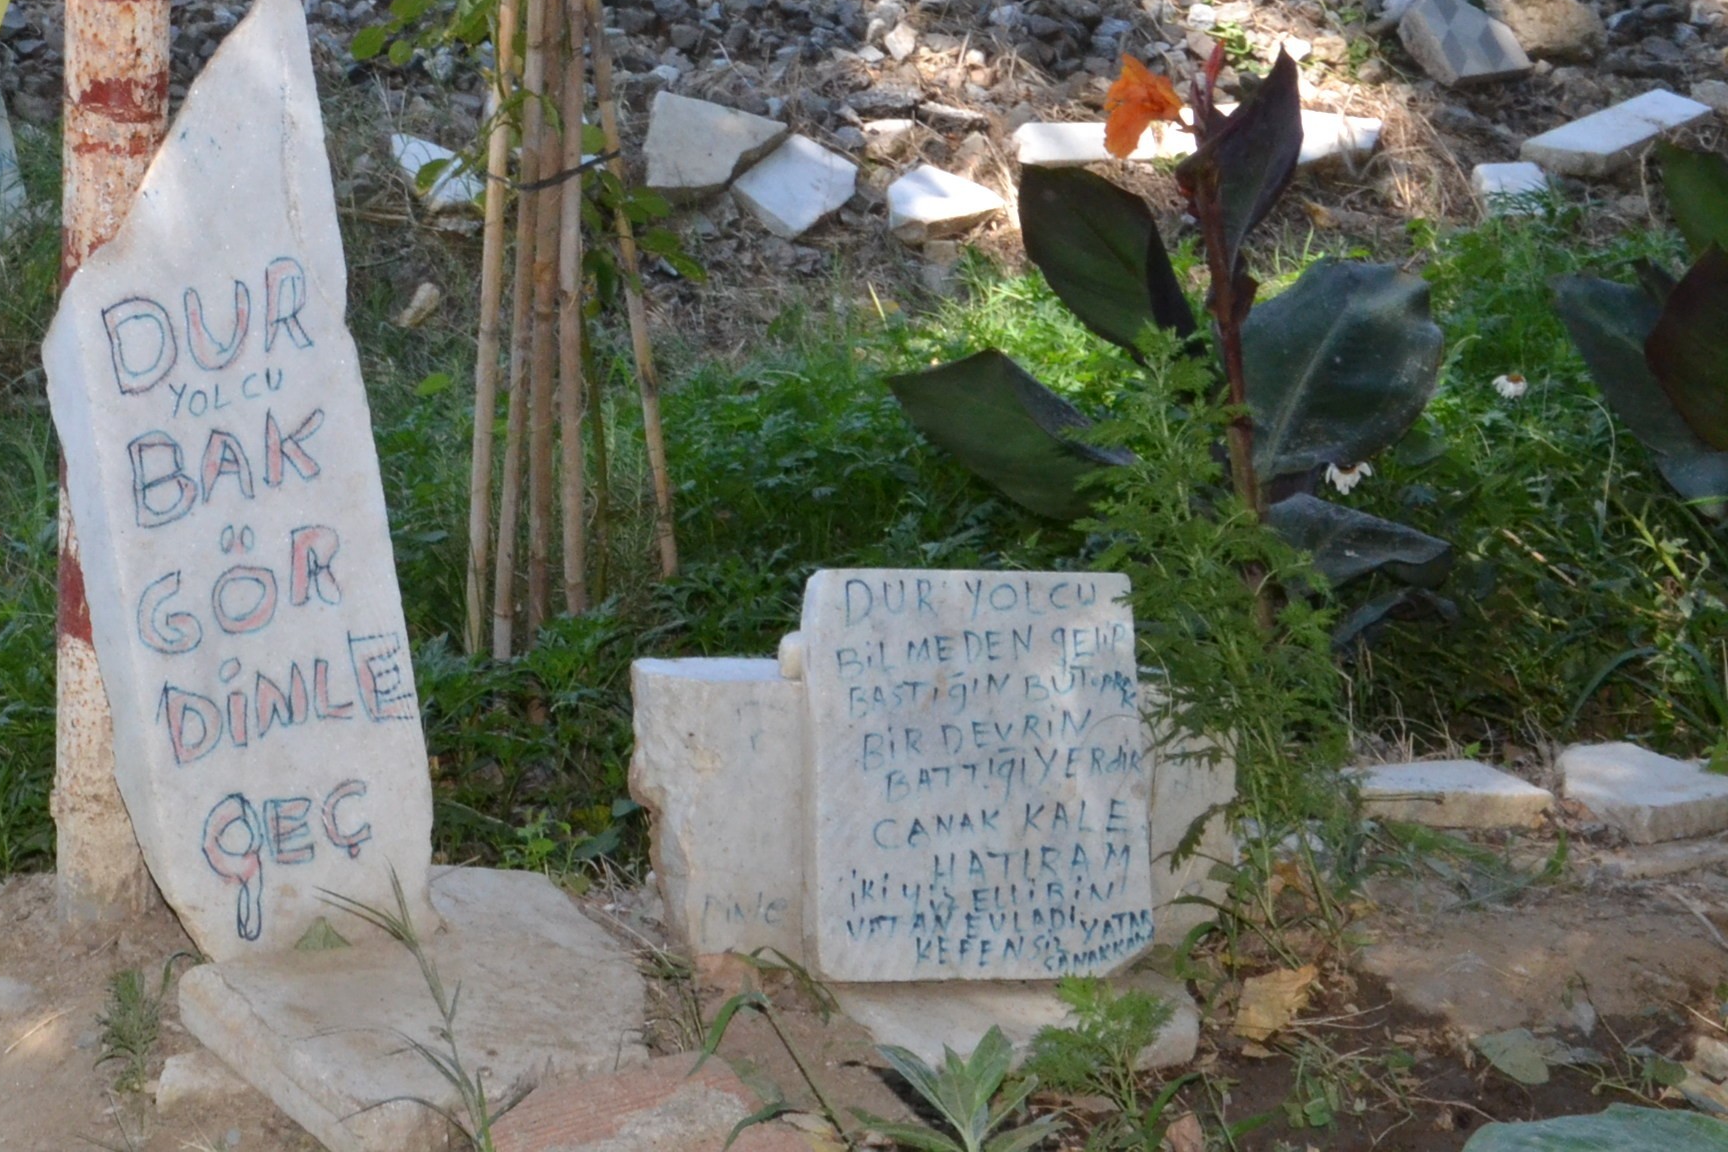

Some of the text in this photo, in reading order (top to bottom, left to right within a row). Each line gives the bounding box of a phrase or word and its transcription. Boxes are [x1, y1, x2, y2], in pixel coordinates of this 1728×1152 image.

[101, 255, 315, 395] DUR
[169, 368, 284, 418] YOLCU
[127, 408, 326, 529] BAK
[137, 524, 342, 654] GÖR
[845, 578, 1097, 628] DUR YOLCU
